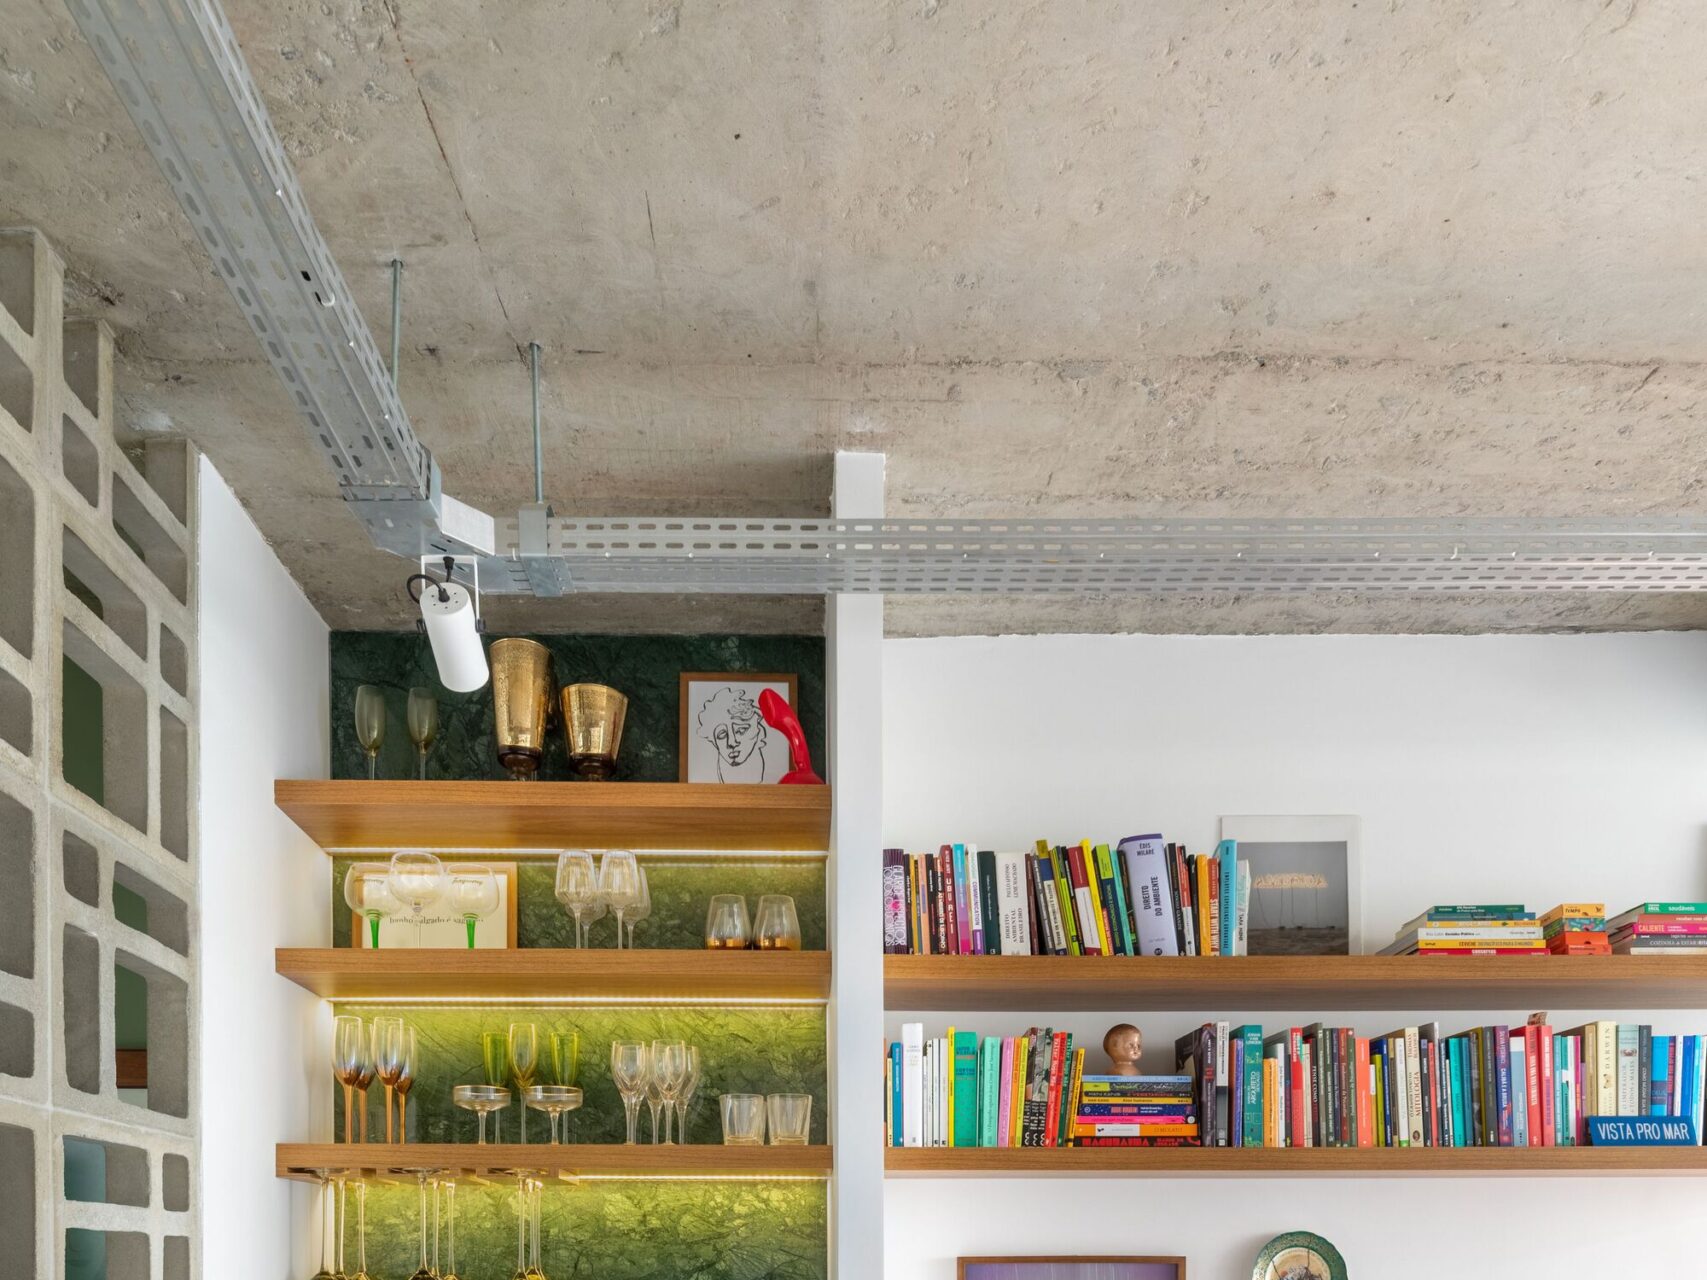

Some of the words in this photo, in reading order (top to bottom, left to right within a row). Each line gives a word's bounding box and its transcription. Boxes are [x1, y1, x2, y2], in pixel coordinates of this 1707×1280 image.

[1141, 885, 1151, 910] DIREITO
[1151, 876, 1161, 906] AMBIENTE
[972, 882, 980, 925] COMMUNICATION
[1154, 907, 1163, 916] DO
[1210, 899, 1218, 918] START
[1211, 919, 1219, 935] WITH
[1414, 1071, 1422, 1116] MITOLOGIA
[1597, 1123, 1635, 1140] VISTA
[1637, 1123, 1661, 1140] PRO
[1663, 1123, 1690, 1140] MAR
